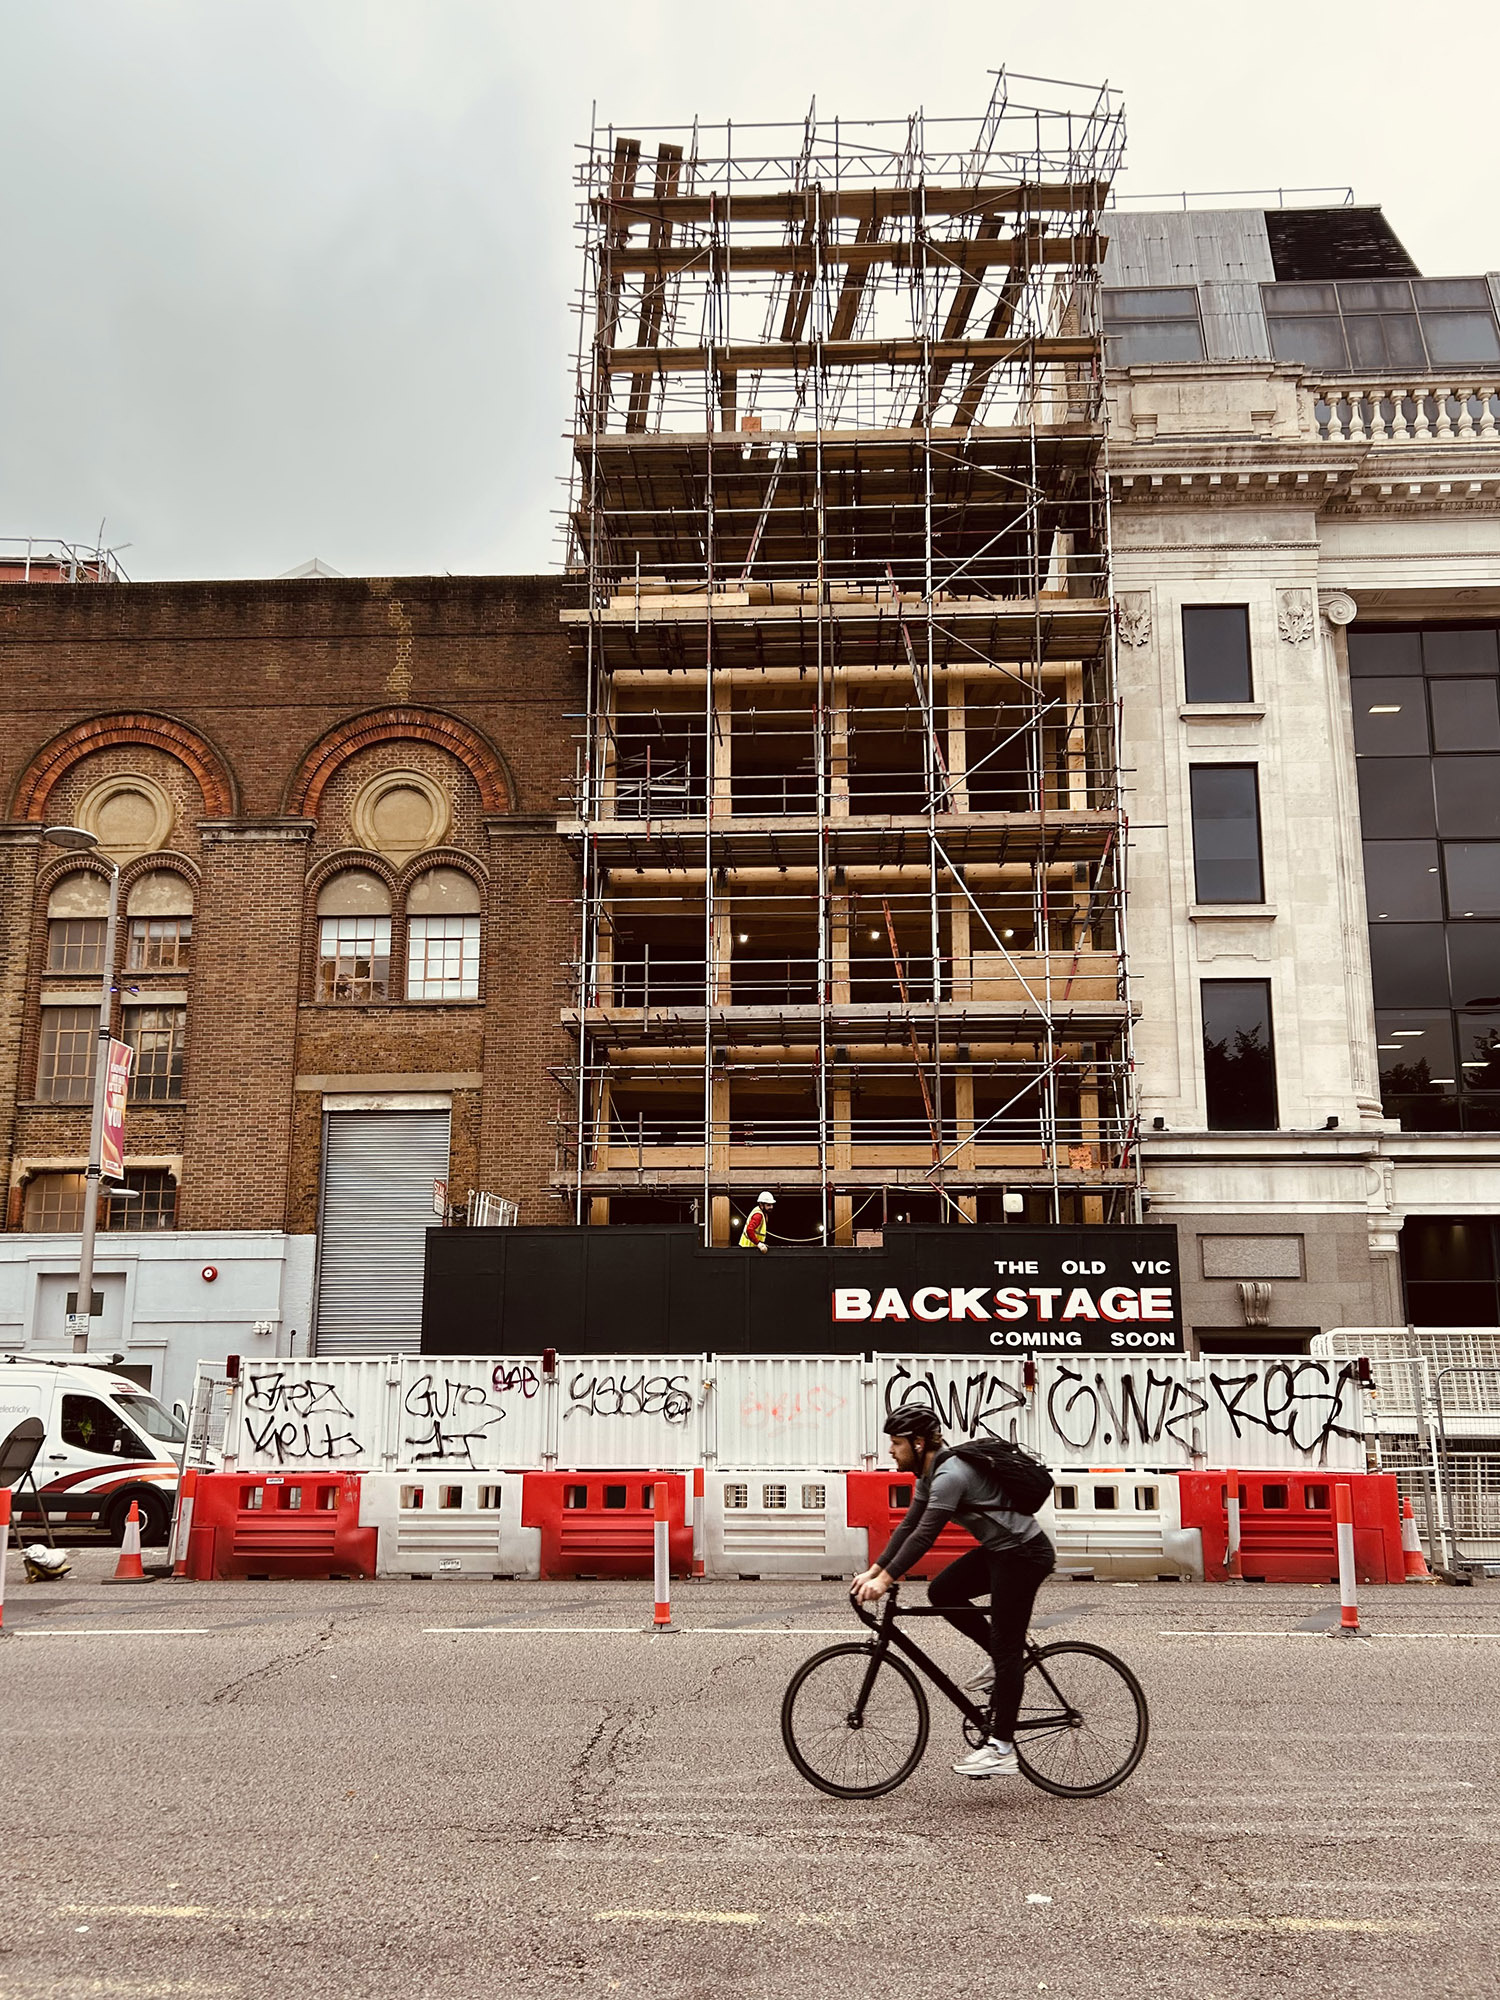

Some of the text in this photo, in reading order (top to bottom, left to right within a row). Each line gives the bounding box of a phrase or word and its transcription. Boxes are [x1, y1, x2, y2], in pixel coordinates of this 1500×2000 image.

[994, 1260, 1171, 1275] THE OLD VIC
[832, 1286, 1174, 1323] BACKSTAGE
[989, 1331, 1175, 1346] COMING SOON
